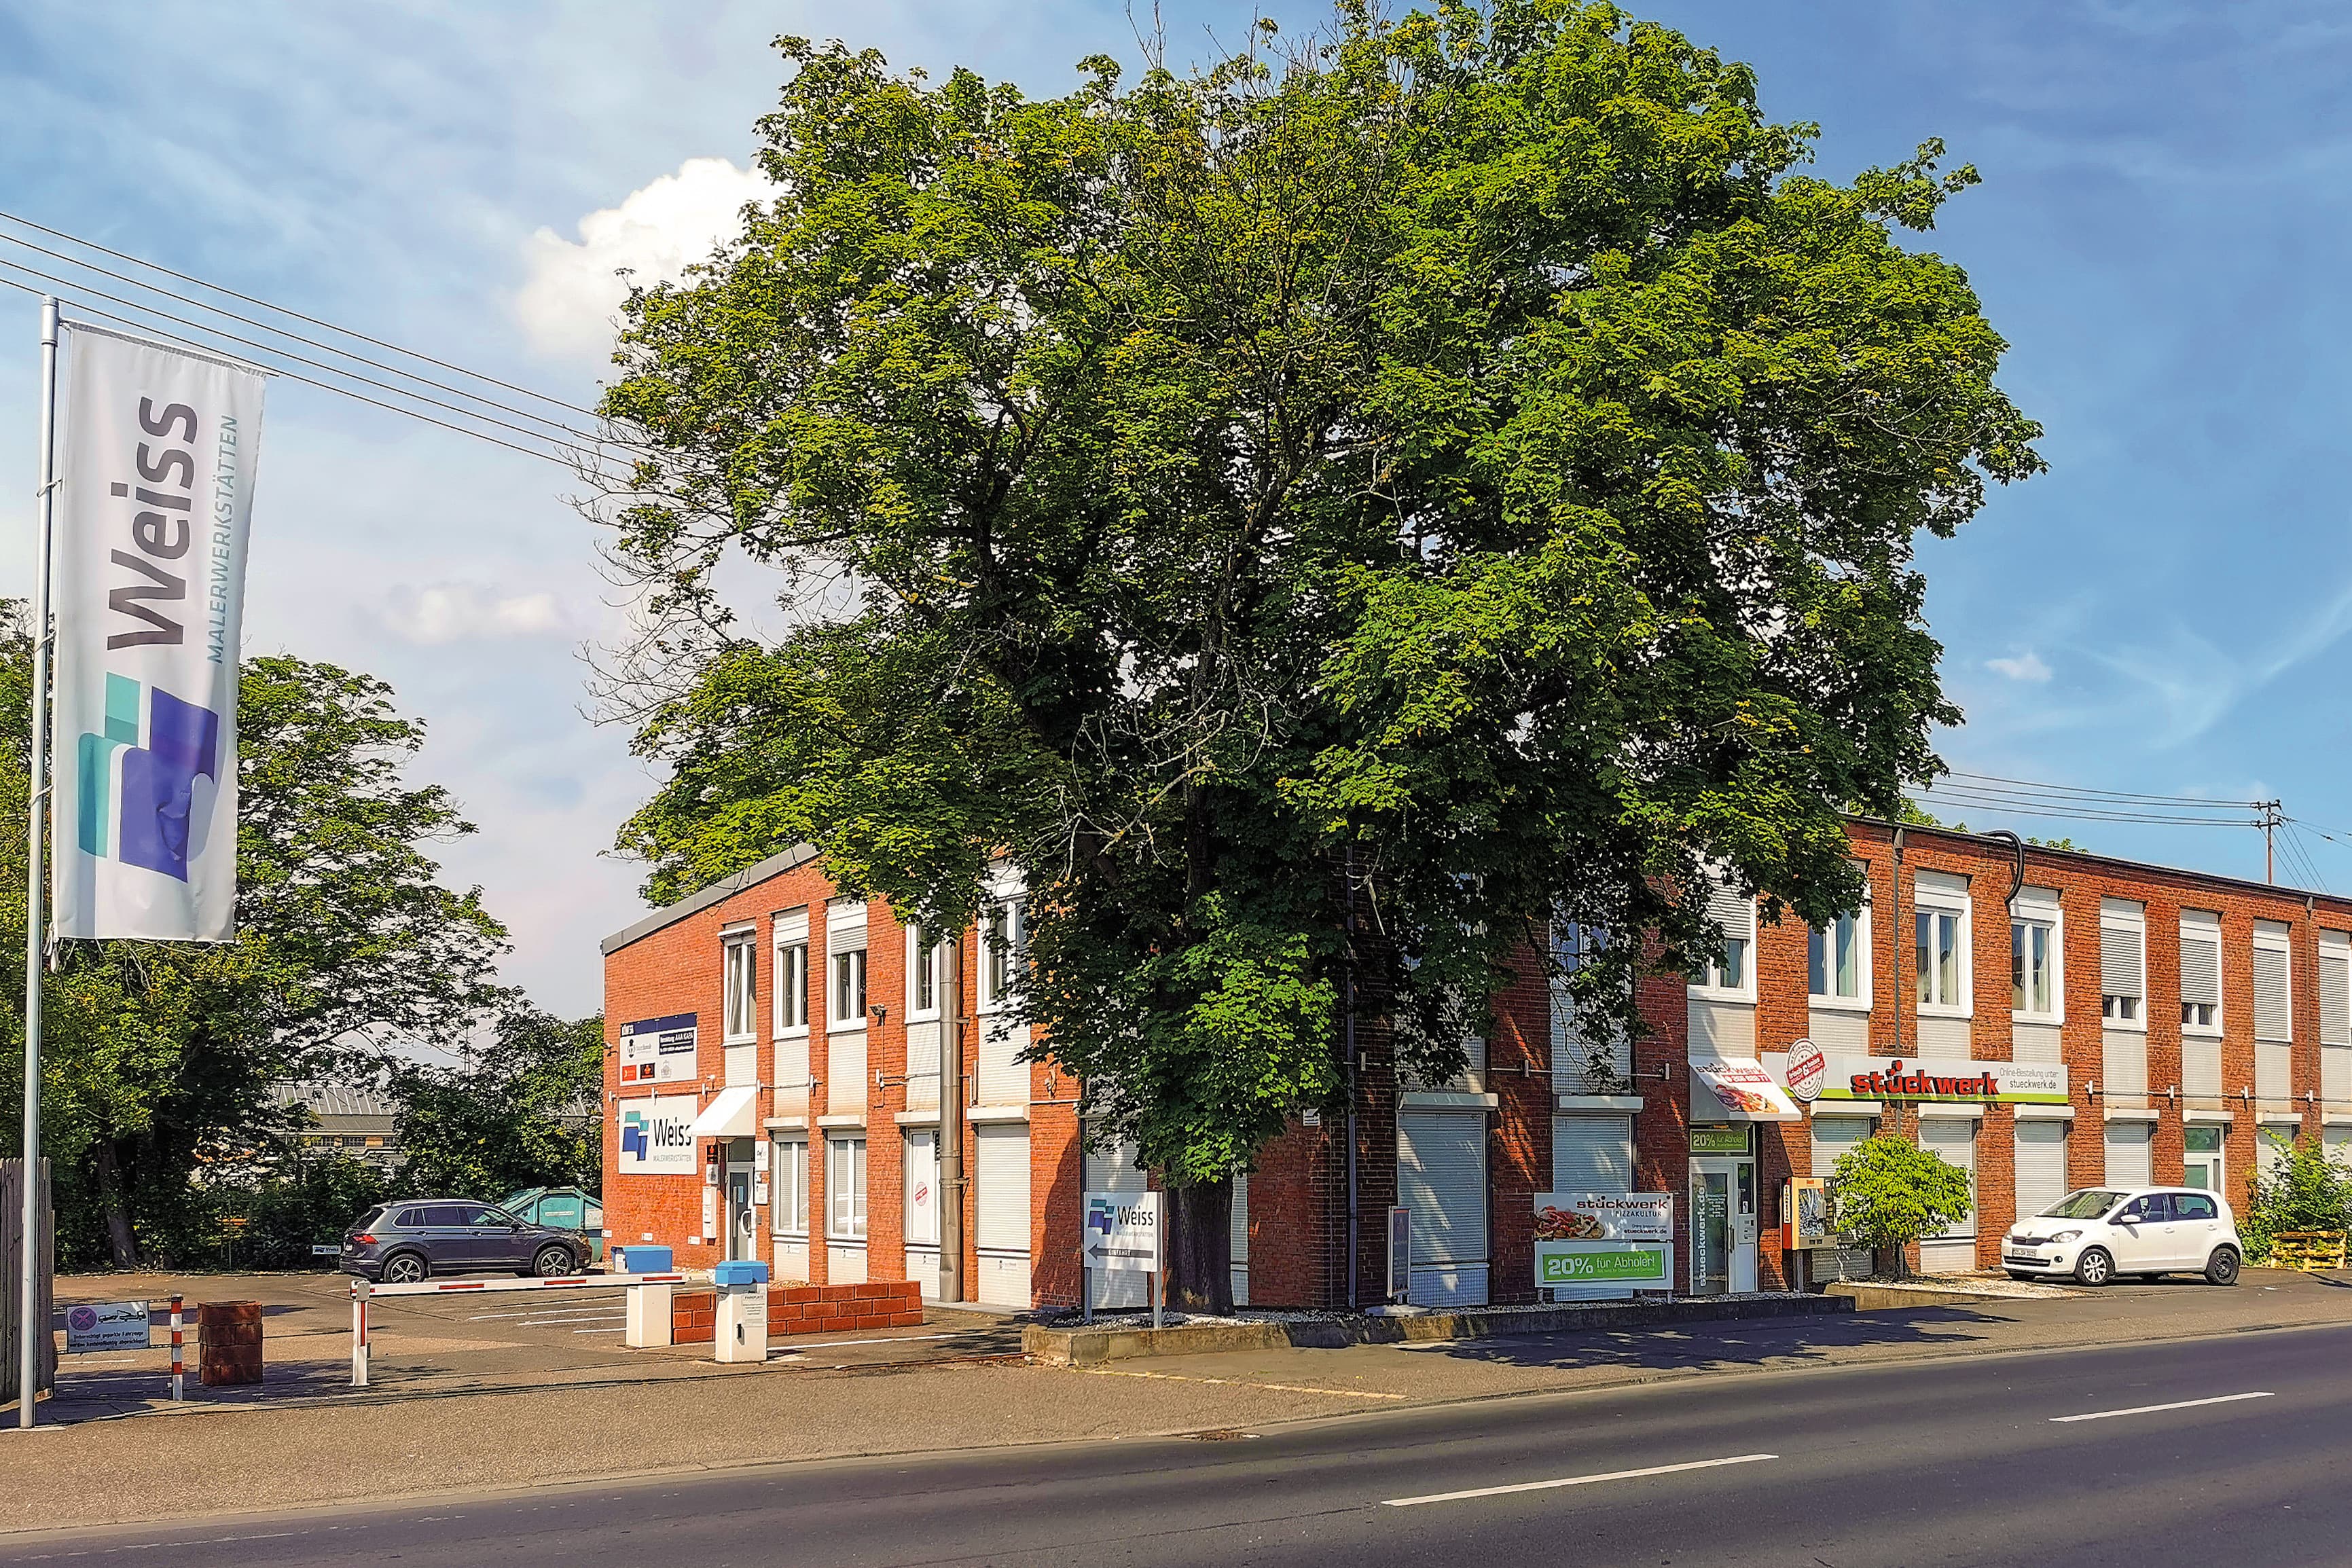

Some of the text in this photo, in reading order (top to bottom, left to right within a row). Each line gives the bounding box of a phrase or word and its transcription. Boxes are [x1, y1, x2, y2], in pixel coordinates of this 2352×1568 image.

[107, 396, 198, 651] Weiss
[206, 415, 238, 665] MALERWERKSTÄTTEN
[1696, 1063, 1764, 1074] stückwerk
[1851, 1059, 2000, 1095] stückwerk
[2010, 1080, 2057, 1089] stueckwerk.de
[1693, 1134, 1716, 1147] 20%
[1576, 1196, 1667, 1209] stückwerk
[1117, 1205, 1154, 1226] Weiss
[1697, 1186, 1707, 1288] stueckwerk.de
[1548, 1258, 1593, 1275] 20%
[1597, 1257, 1610, 1269] für
[1614, 1255, 1655, 1268] Abholer!
